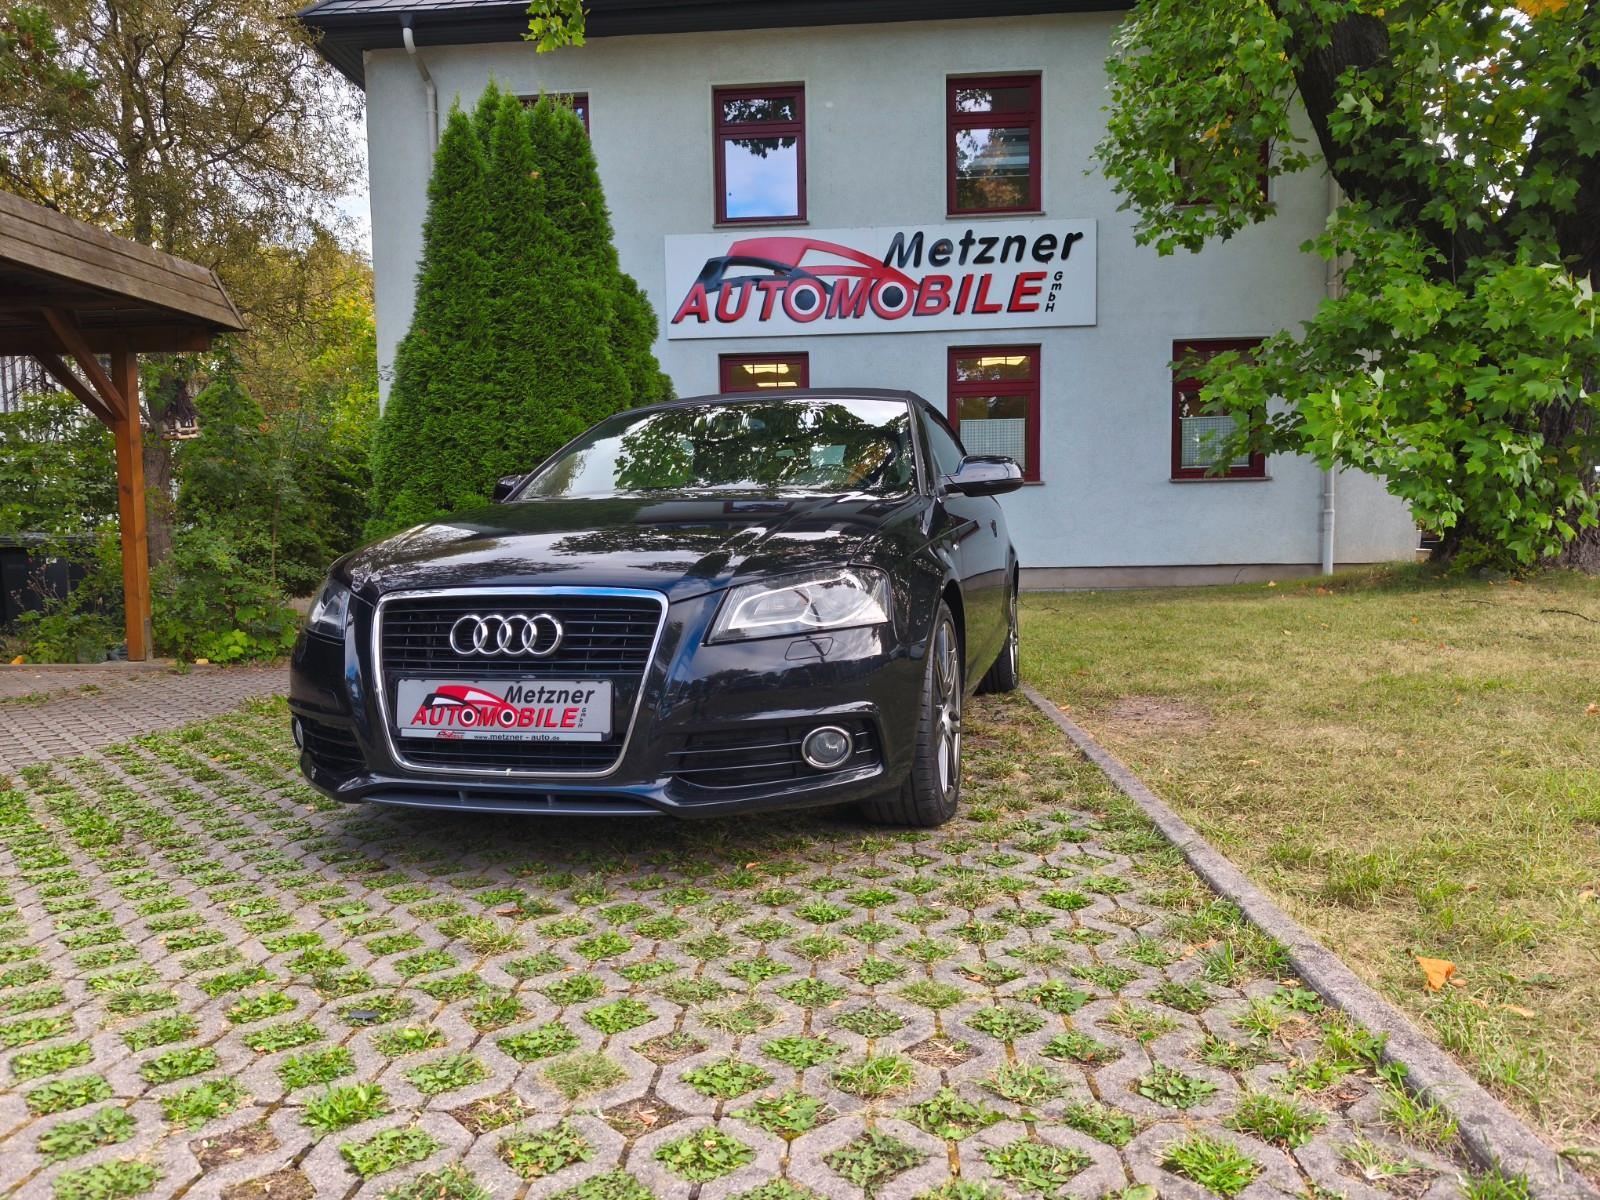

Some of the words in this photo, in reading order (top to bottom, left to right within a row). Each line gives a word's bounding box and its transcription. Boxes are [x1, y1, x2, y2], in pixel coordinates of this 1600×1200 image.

[883, 229, 1084, 268] Metzner
[671, 271, 1048, 325] AUTOMOBILE
[1045, 271, 1063, 312] GmbH
[504, 685, 595, 704] Metzner
[411, 707, 579, 729] AUTOMOBILE
